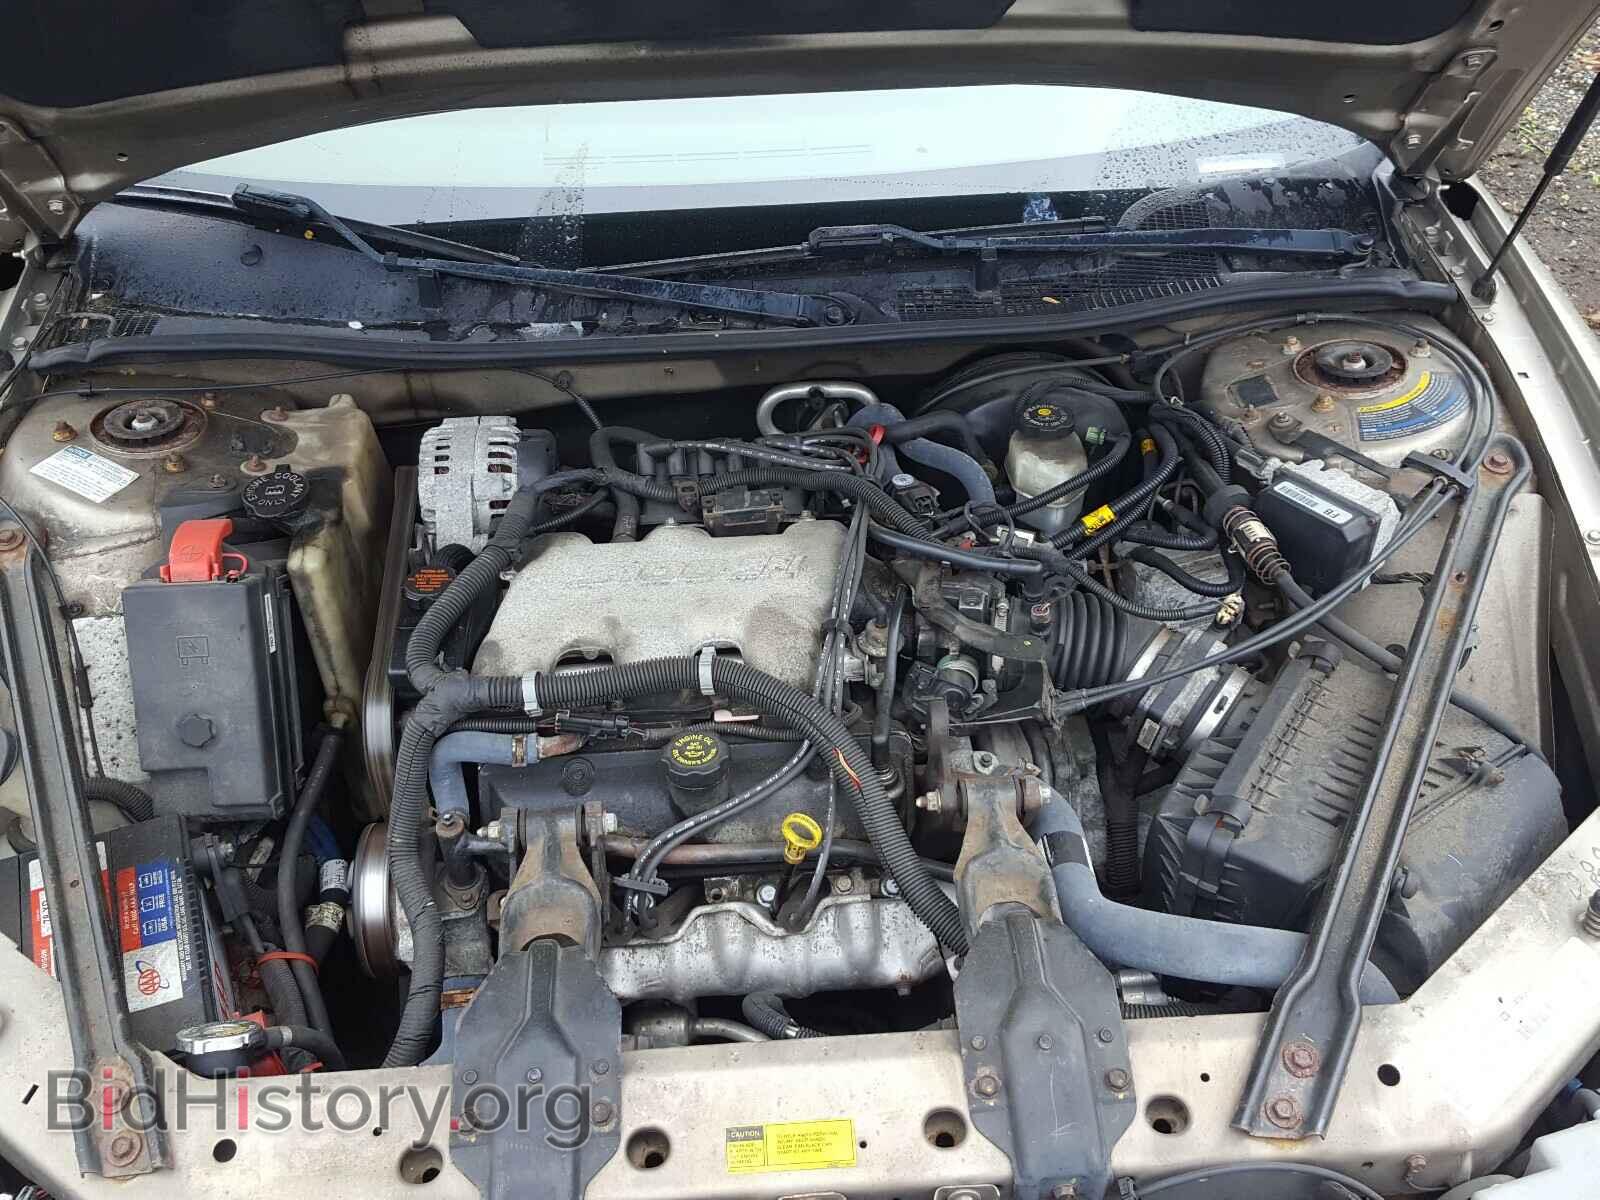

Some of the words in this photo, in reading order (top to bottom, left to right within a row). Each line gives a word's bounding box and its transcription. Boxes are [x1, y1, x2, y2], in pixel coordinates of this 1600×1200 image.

[274, 472, 304, 498] COOLANT
[258, 497, 288, 506] ONLY
[675, 734, 703, 747] ENGINE
[731, 1130, 760, 1138] CAUTION
